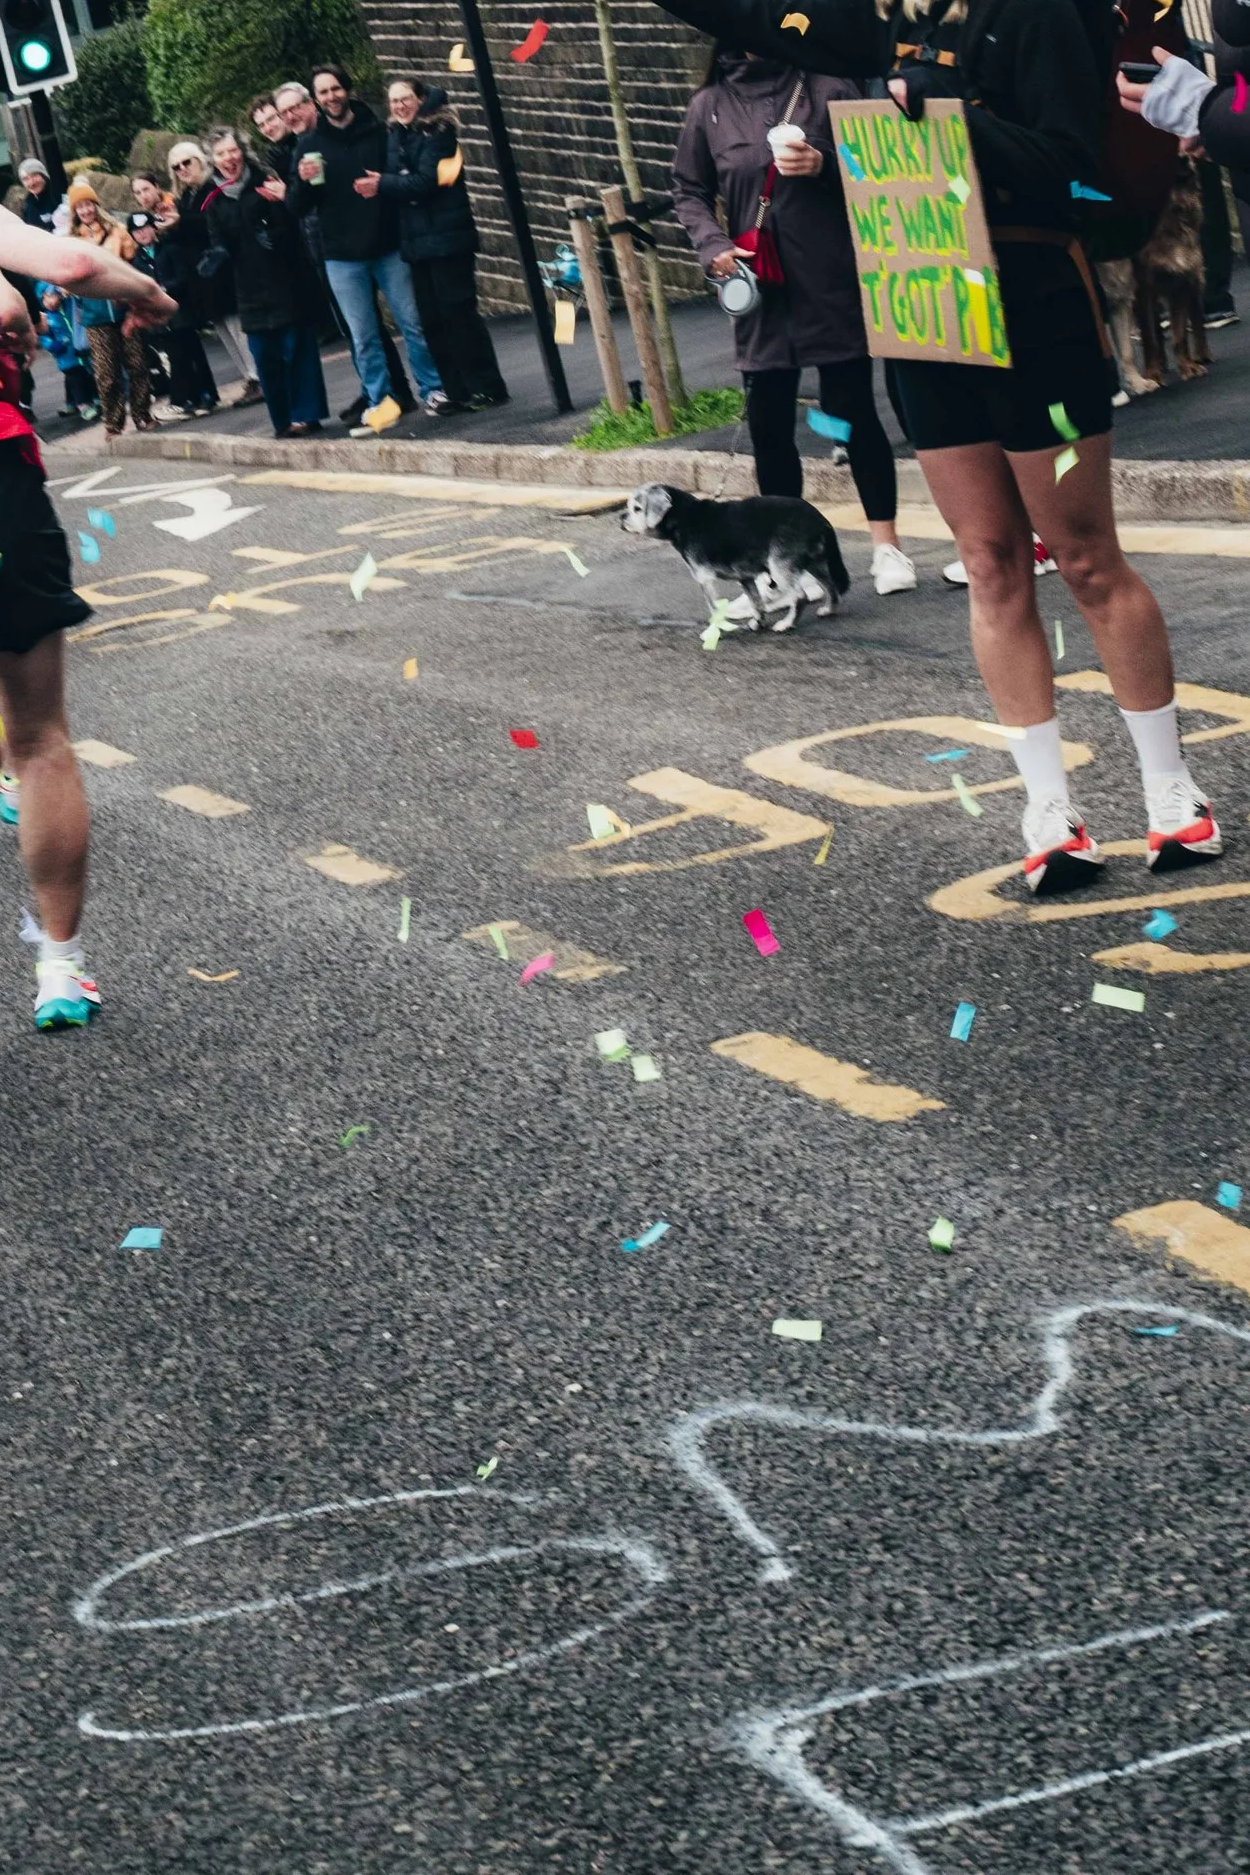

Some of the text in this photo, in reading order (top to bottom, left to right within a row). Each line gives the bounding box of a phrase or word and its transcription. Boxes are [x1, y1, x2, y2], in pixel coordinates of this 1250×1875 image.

[839, 113, 970, 187] HURRY UP
[851, 191, 970, 260] WE WANT
